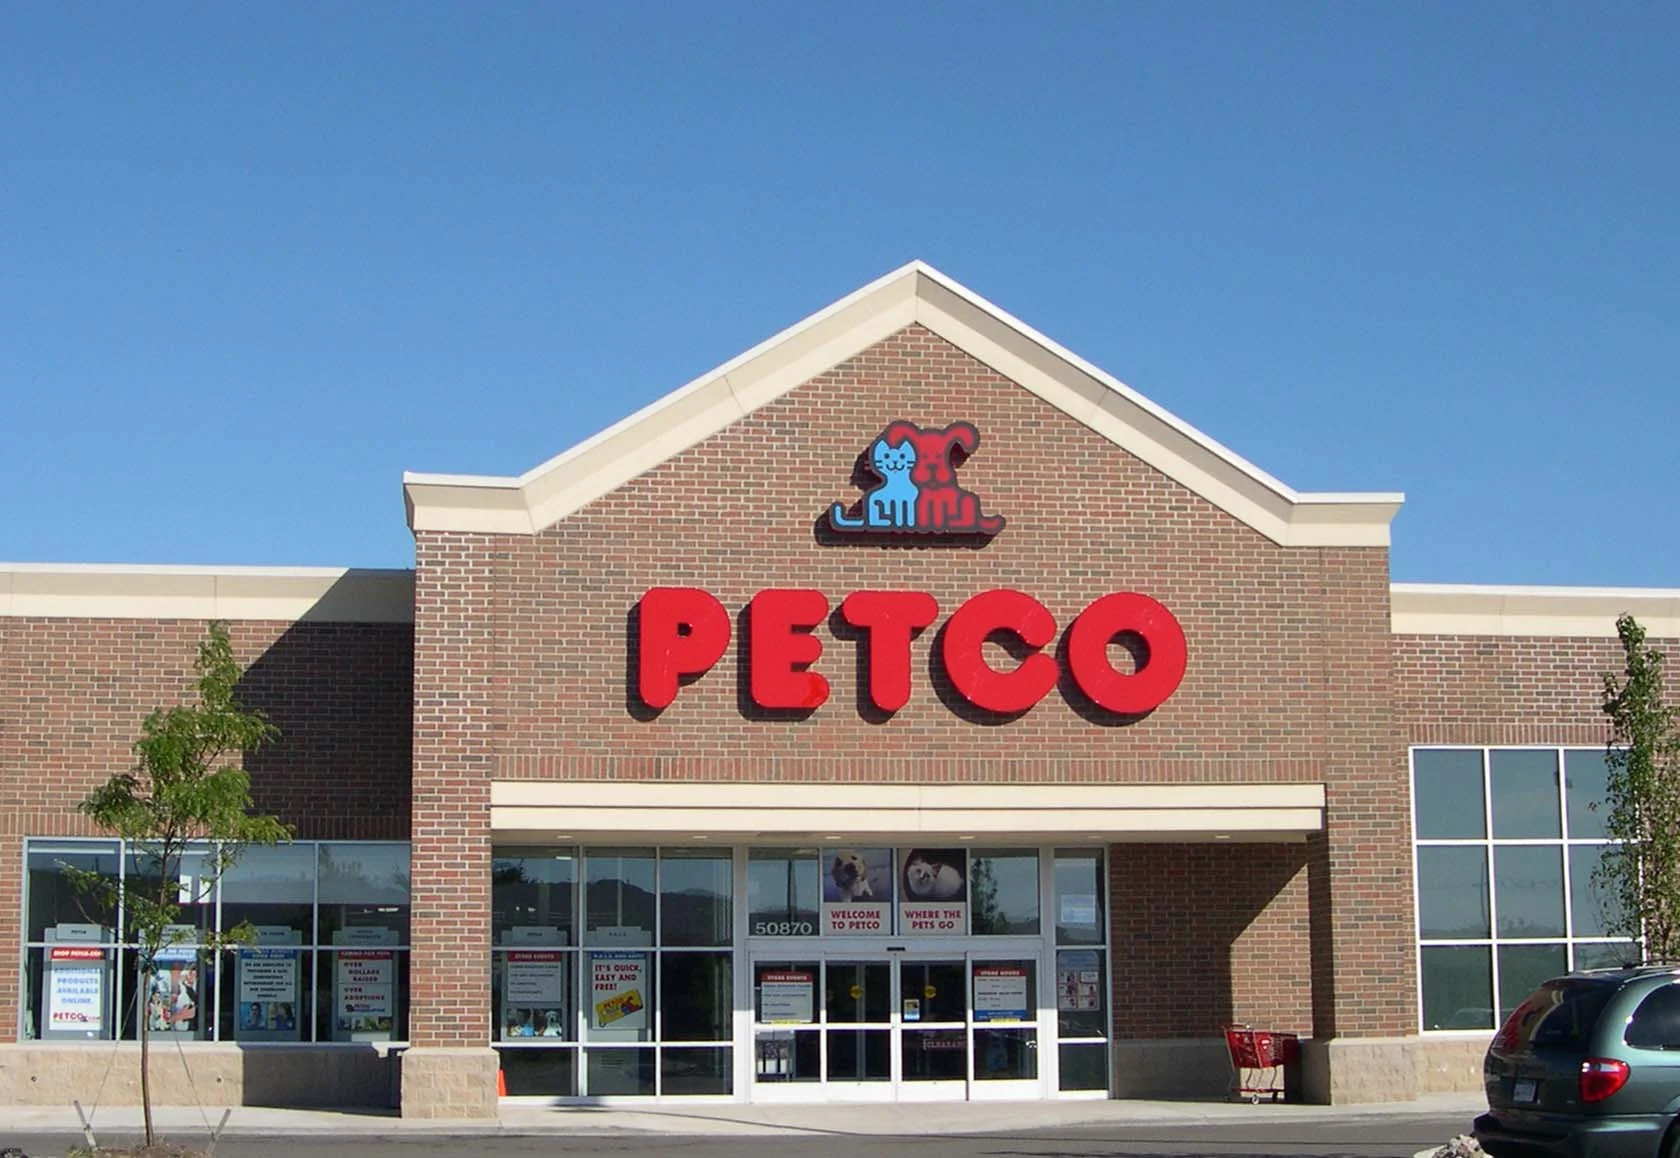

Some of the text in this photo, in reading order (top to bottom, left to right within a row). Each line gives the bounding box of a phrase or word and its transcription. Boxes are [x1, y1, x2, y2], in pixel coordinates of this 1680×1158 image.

[637, 586, 1188, 715] PETCO
[830, 910, 881, 919] WELCOME
[904, 910, 961, 919] WHERE THE
[755, 922, 813, 935] 50870
[832, 920, 880, 929] TO PETCO
[912, 921, 955, 929] PETS GO
[595, 964, 611, 972] IT'S
